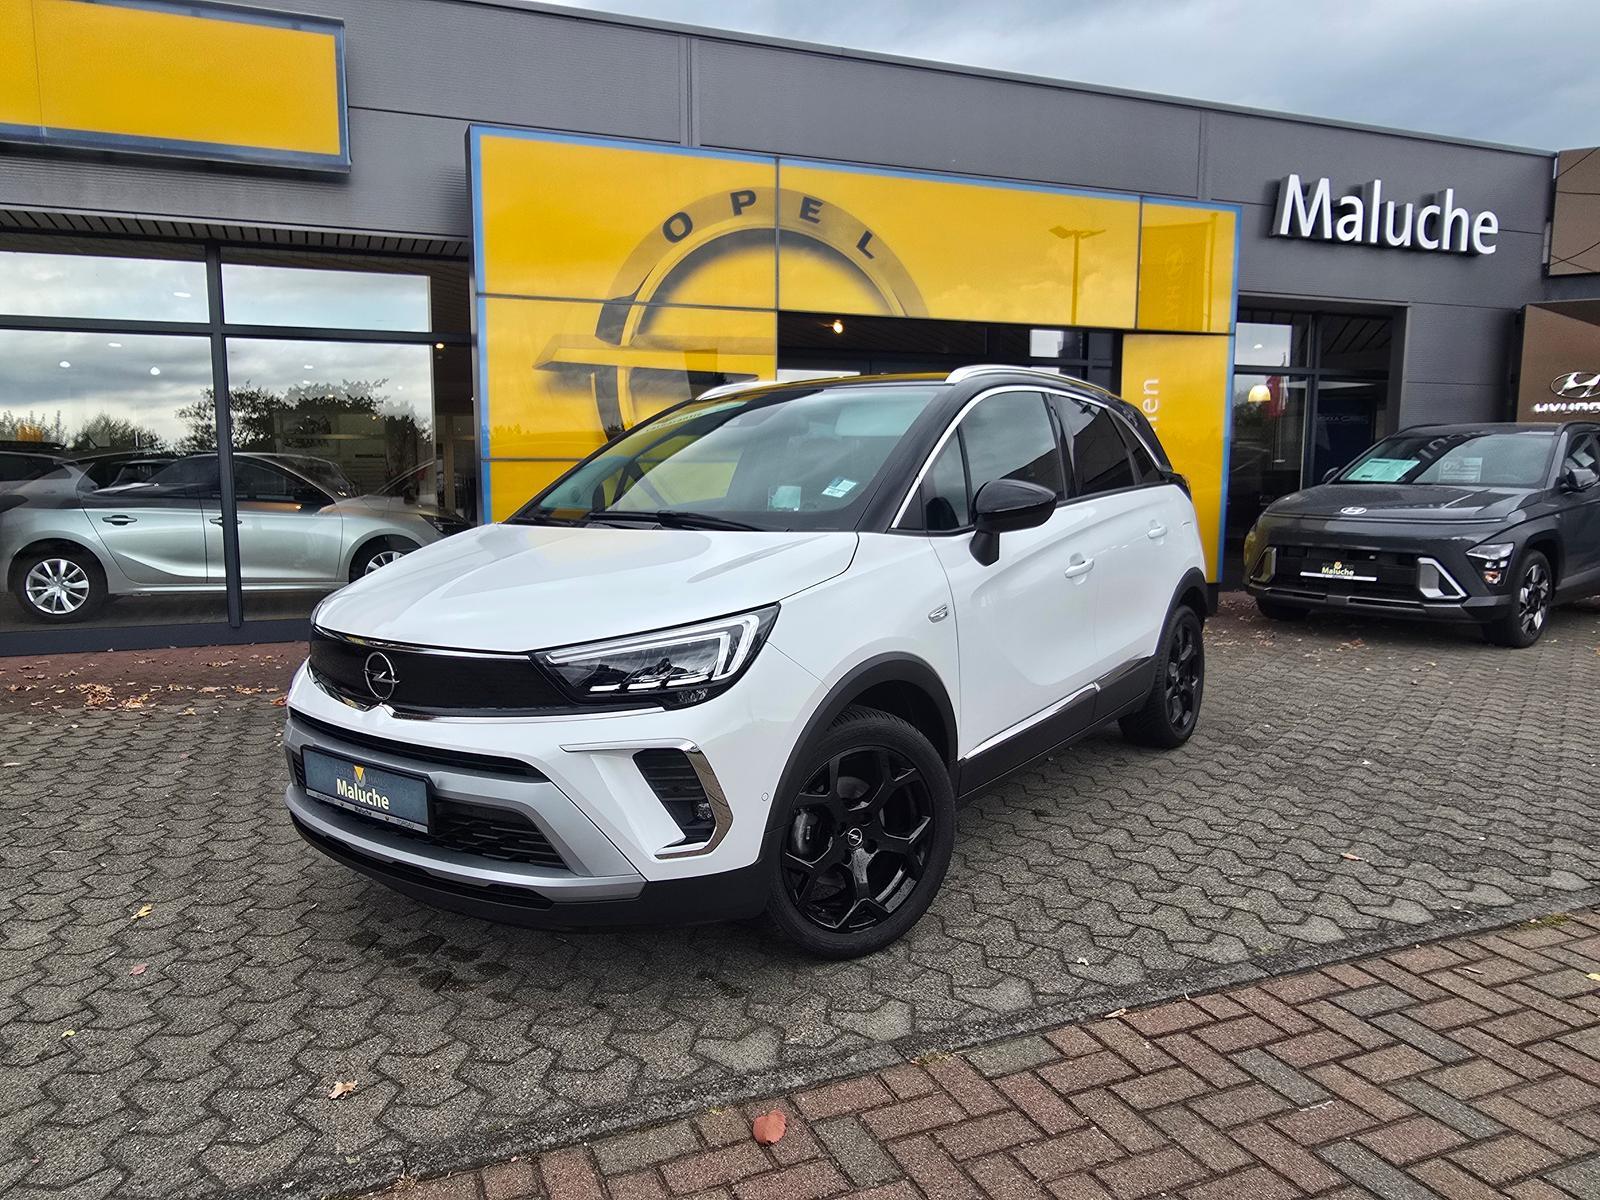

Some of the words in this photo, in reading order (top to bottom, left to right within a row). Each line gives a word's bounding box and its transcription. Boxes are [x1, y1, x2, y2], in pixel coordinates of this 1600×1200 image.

[661, 188, 875, 260] OPEL
[1276, 173, 1499, 254] Maluche
[1321, 566, 1355, 576] Maluche
[336, 778, 390, 811] Maluche
